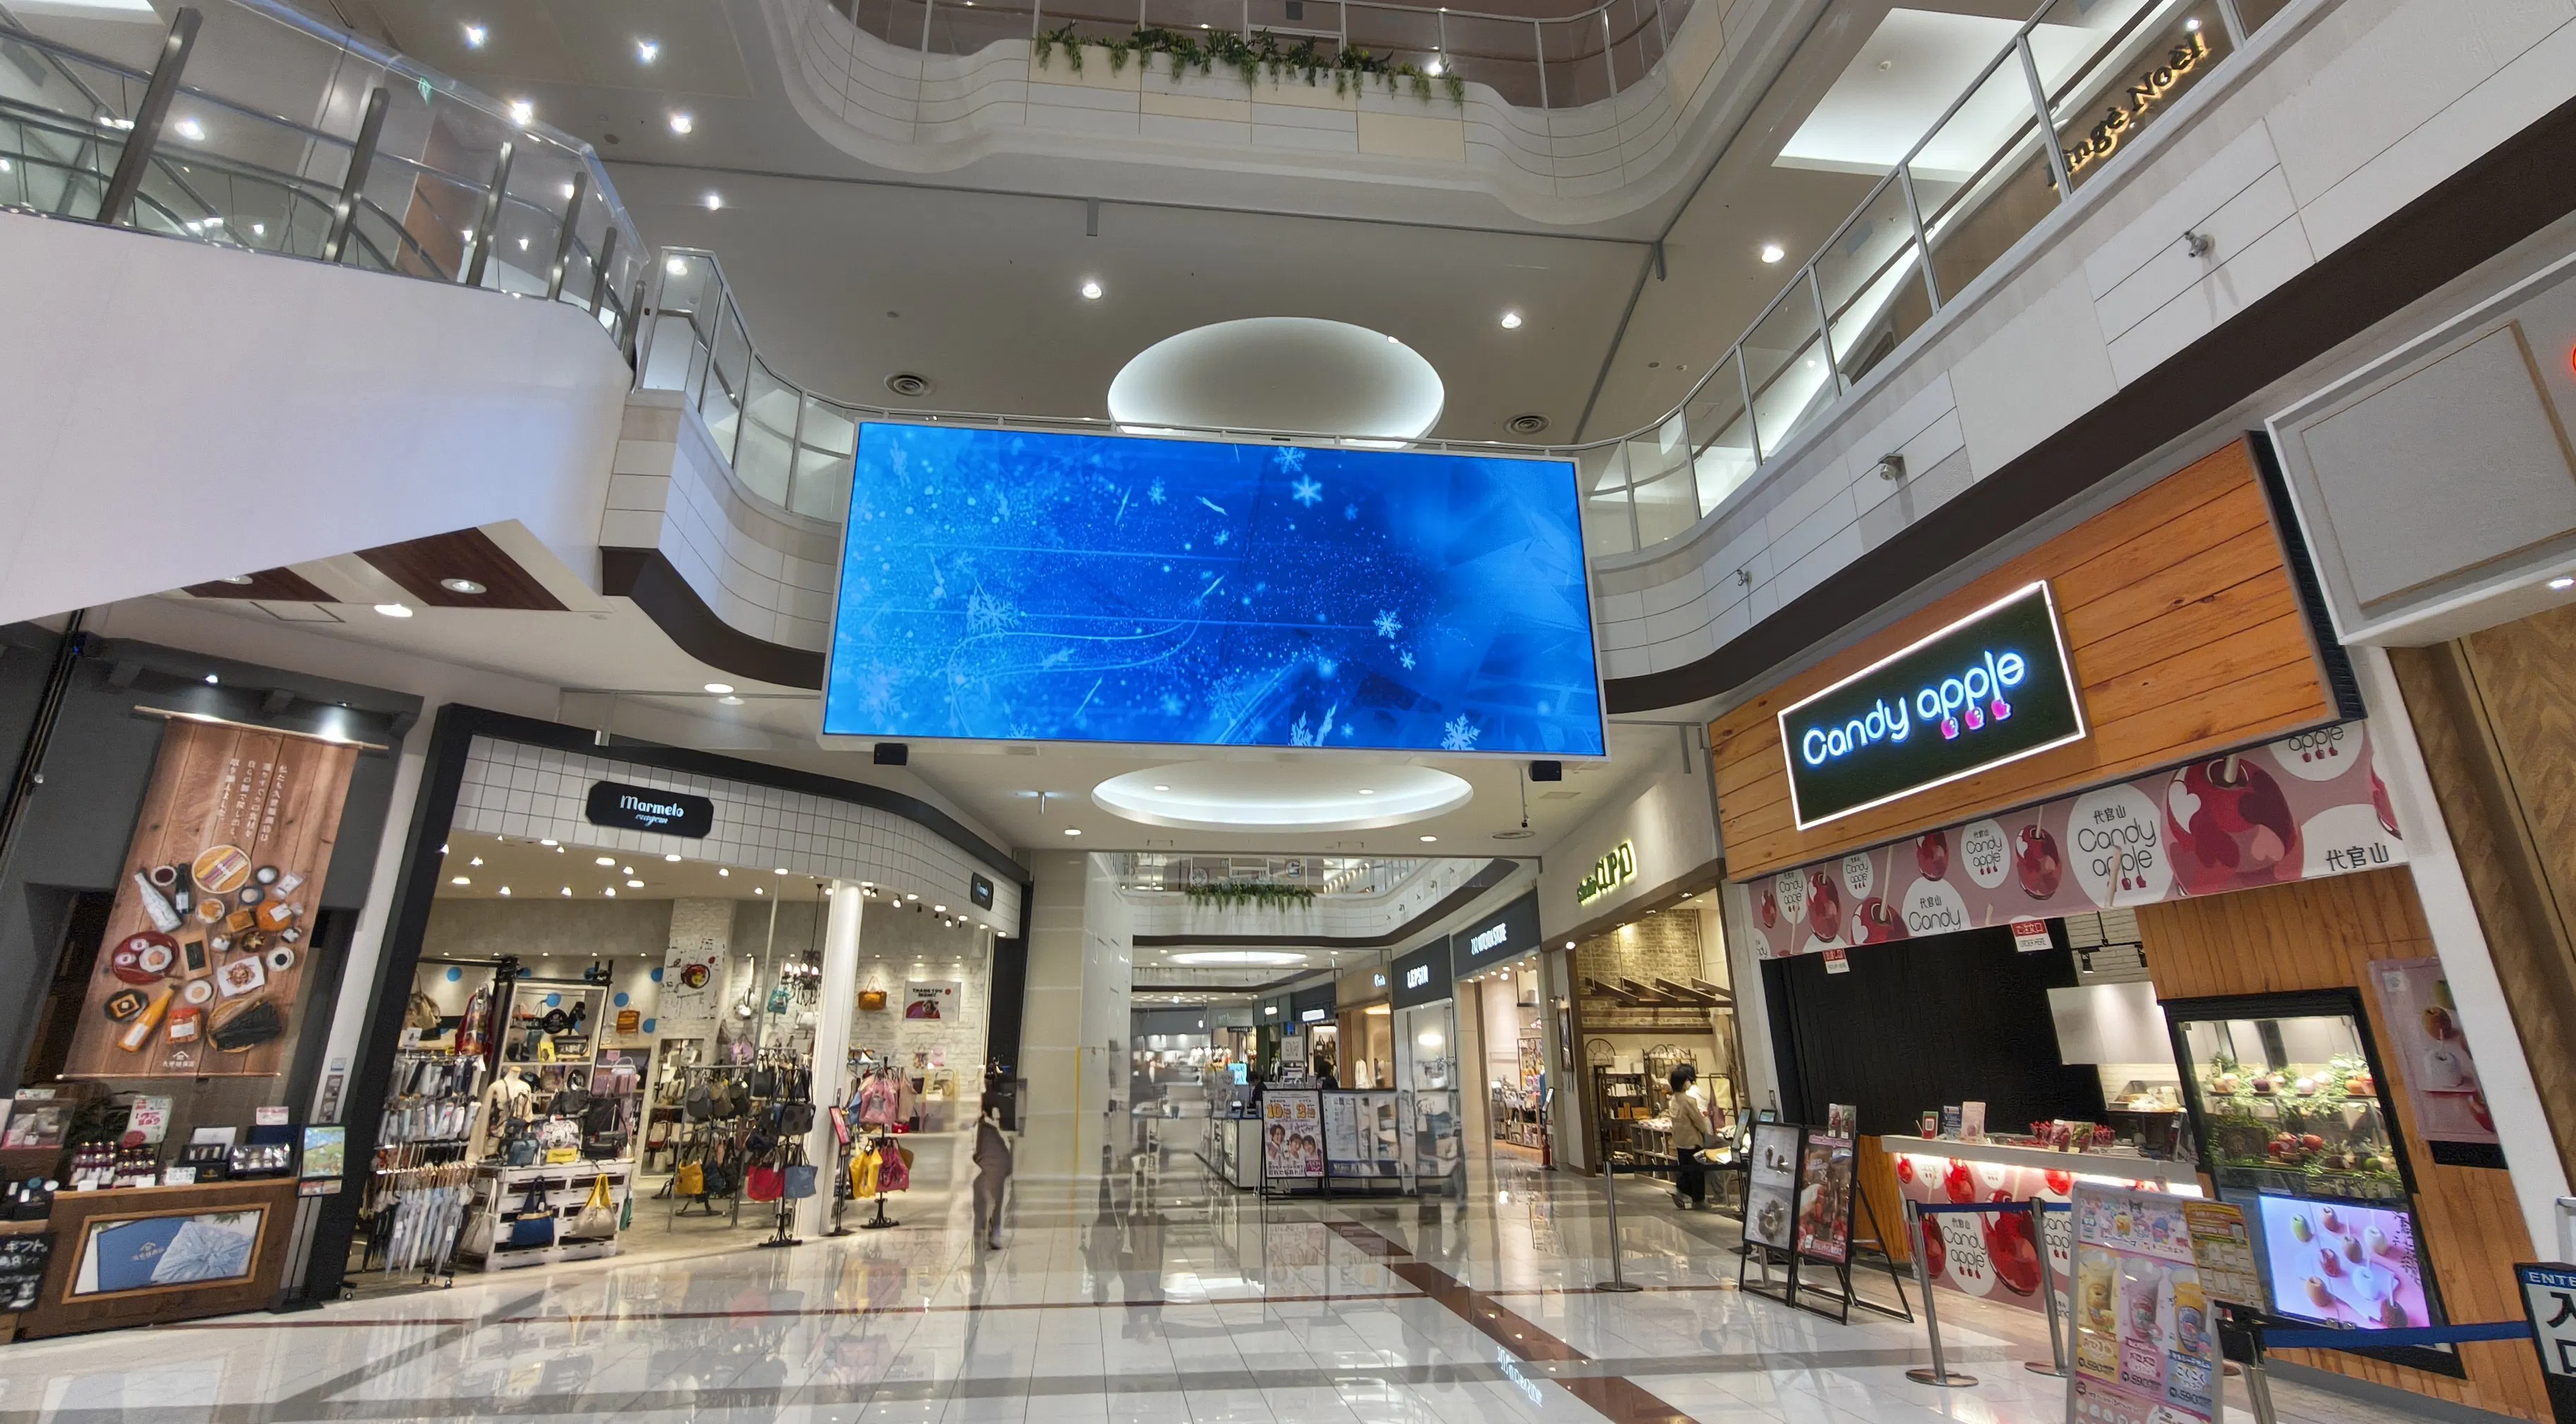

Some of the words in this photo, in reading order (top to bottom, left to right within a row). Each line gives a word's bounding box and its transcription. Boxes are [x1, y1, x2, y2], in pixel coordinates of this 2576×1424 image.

[1802, 696, 1911, 766] Candy
[1916, 650, 2026, 725] apple
[2288, 726, 2344, 751] apple
[620, 794, 684, 818] Marmelo
[2094, 805, 2126, 824] 代官山
[1966, 835, 2002, 854] Candy
[2078, 818, 2156, 852] Candy
[1973, 851, 2001, 868] apple
[2326, 842, 2390, 871] 代官山
[1909, 906, 1961, 932] Candy
[1942, 1226, 1987, 1255] Candy
[1950, 1248, 1985, 1269] apple
